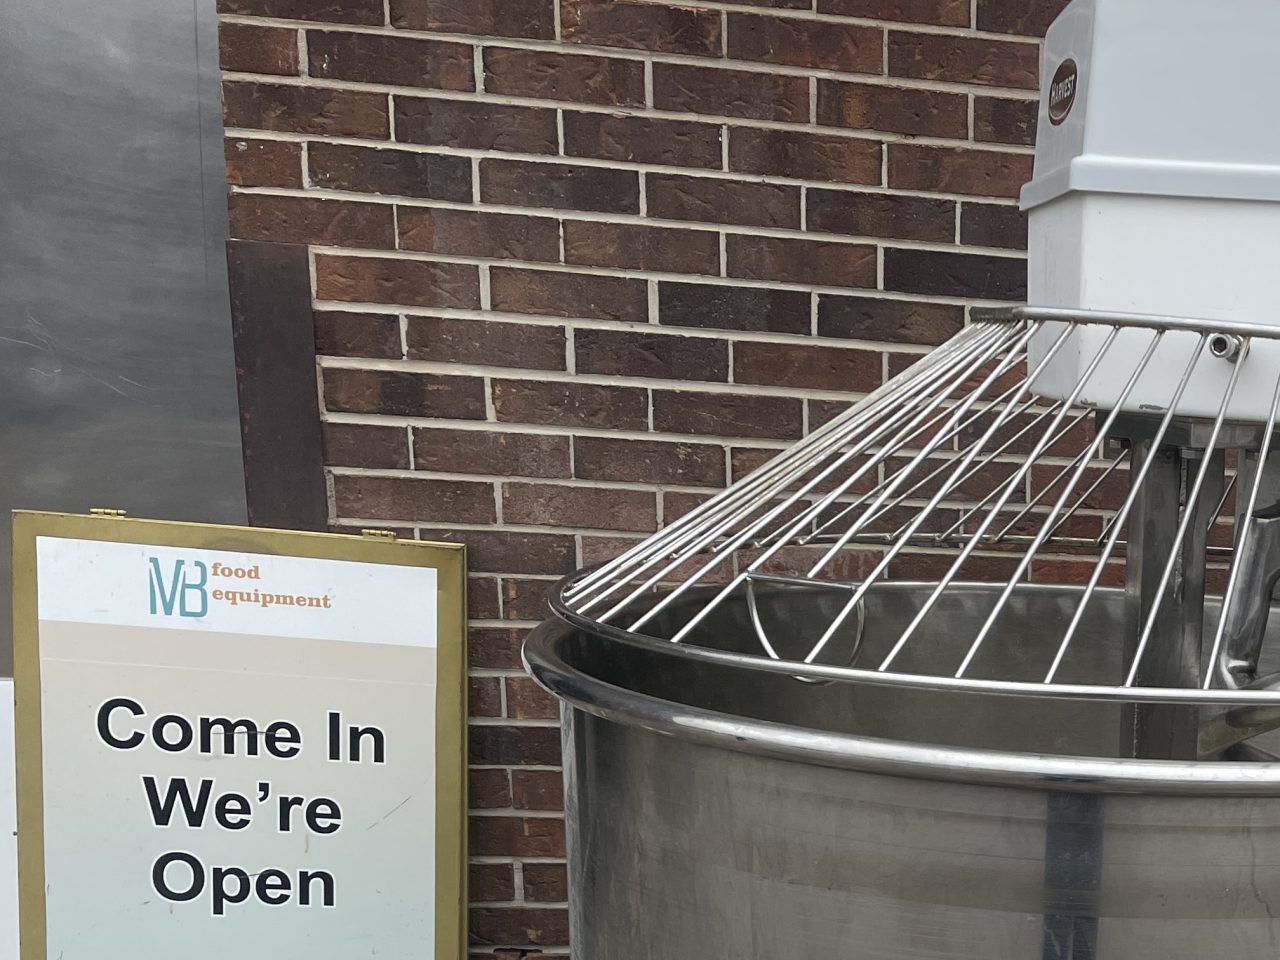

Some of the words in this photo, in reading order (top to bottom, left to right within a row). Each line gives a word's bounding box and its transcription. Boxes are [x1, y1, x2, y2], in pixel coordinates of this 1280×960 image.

[1050, 73, 1076, 107] HARVEST
[211, 562, 260, 580] food
[211, 587, 332, 610] equipment
[97, 698, 301, 758] Come
[328, 712, 386, 763] In
[152, 852, 334, 915] Open
